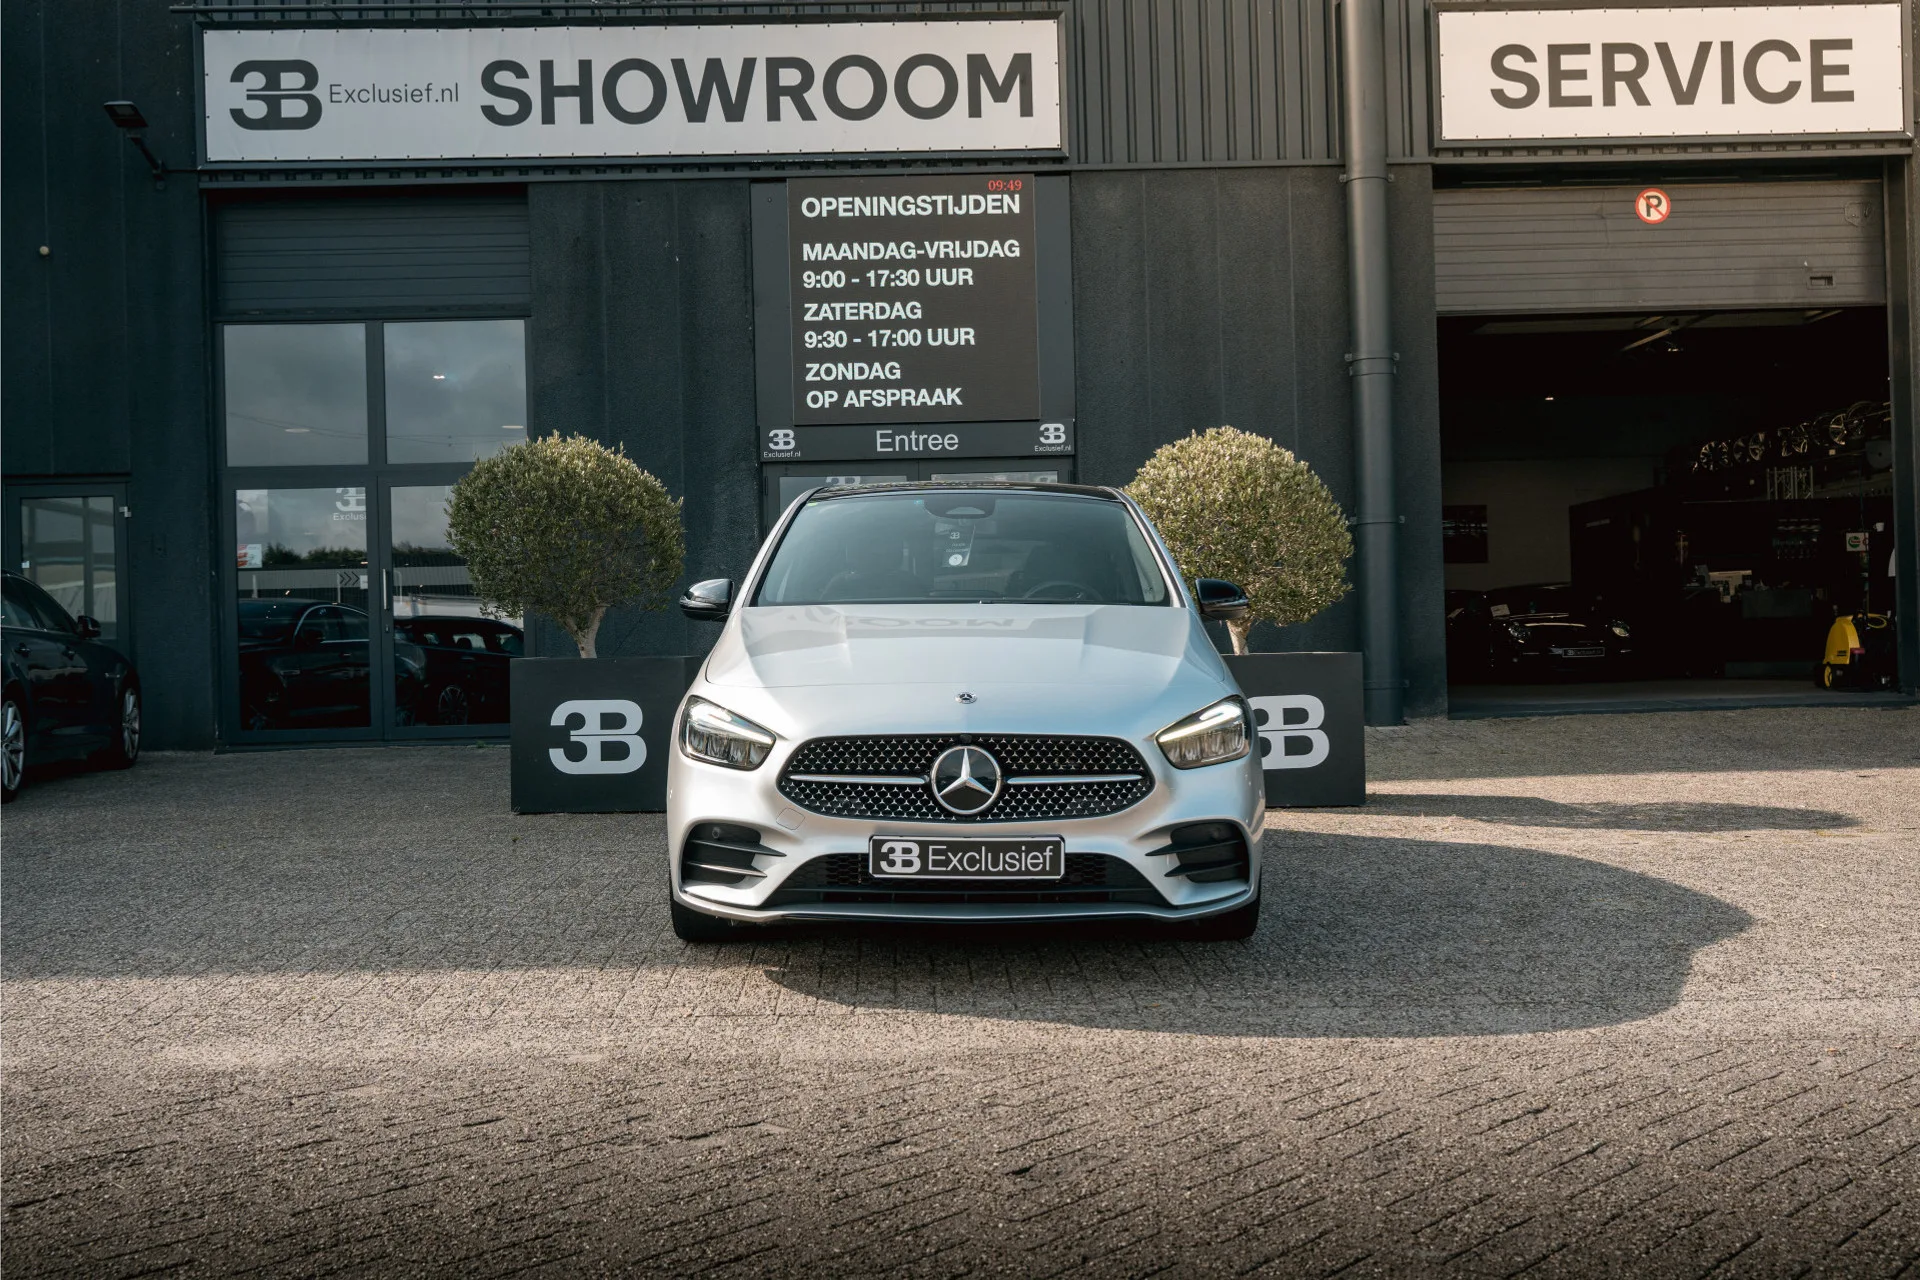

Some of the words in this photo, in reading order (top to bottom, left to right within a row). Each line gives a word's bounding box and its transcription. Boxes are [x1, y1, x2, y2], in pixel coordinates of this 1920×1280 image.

[1490, 38, 1855, 110] SERVICE
[229, 59, 323, 131] 3B
[329, 82, 459, 104] Exclusief.nl
[480, 52, 1034, 127] SHOWROOM
[988, 180, 1022, 192] 09:49
[801, 194, 1020, 217] OPENINGSTIJDEN
[802, 239, 1020, 261] MAANDAG-VRIJDAG
[803, 270, 846, 288] 9:00
[866, 269, 920, 287] 17:30
[926, 268, 974, 285] UUR
[803, 302, 922, 321] ZATERDAG
[804, 330, 847, 348] 9:30
[868, 329, 921, 347] 17:00
[927, 328, 975, 345] UUR
[805, 362, 901, 381] ZONDAG
[806, 391, 838, 408] OP
[843, 388, 963, 408] AFSPRAAK
[768, 429, 796, 450] 3B
[876, 429, 959, 452] Entree
[1039, 423, 1066, 444] 3B
[763, 450, 801, 458] Exclusief.nl
[549, 699, 647, 775] 3B
[880, 841, 922, 874] 3B
[928, 845, 1053, 872] Exclusief
